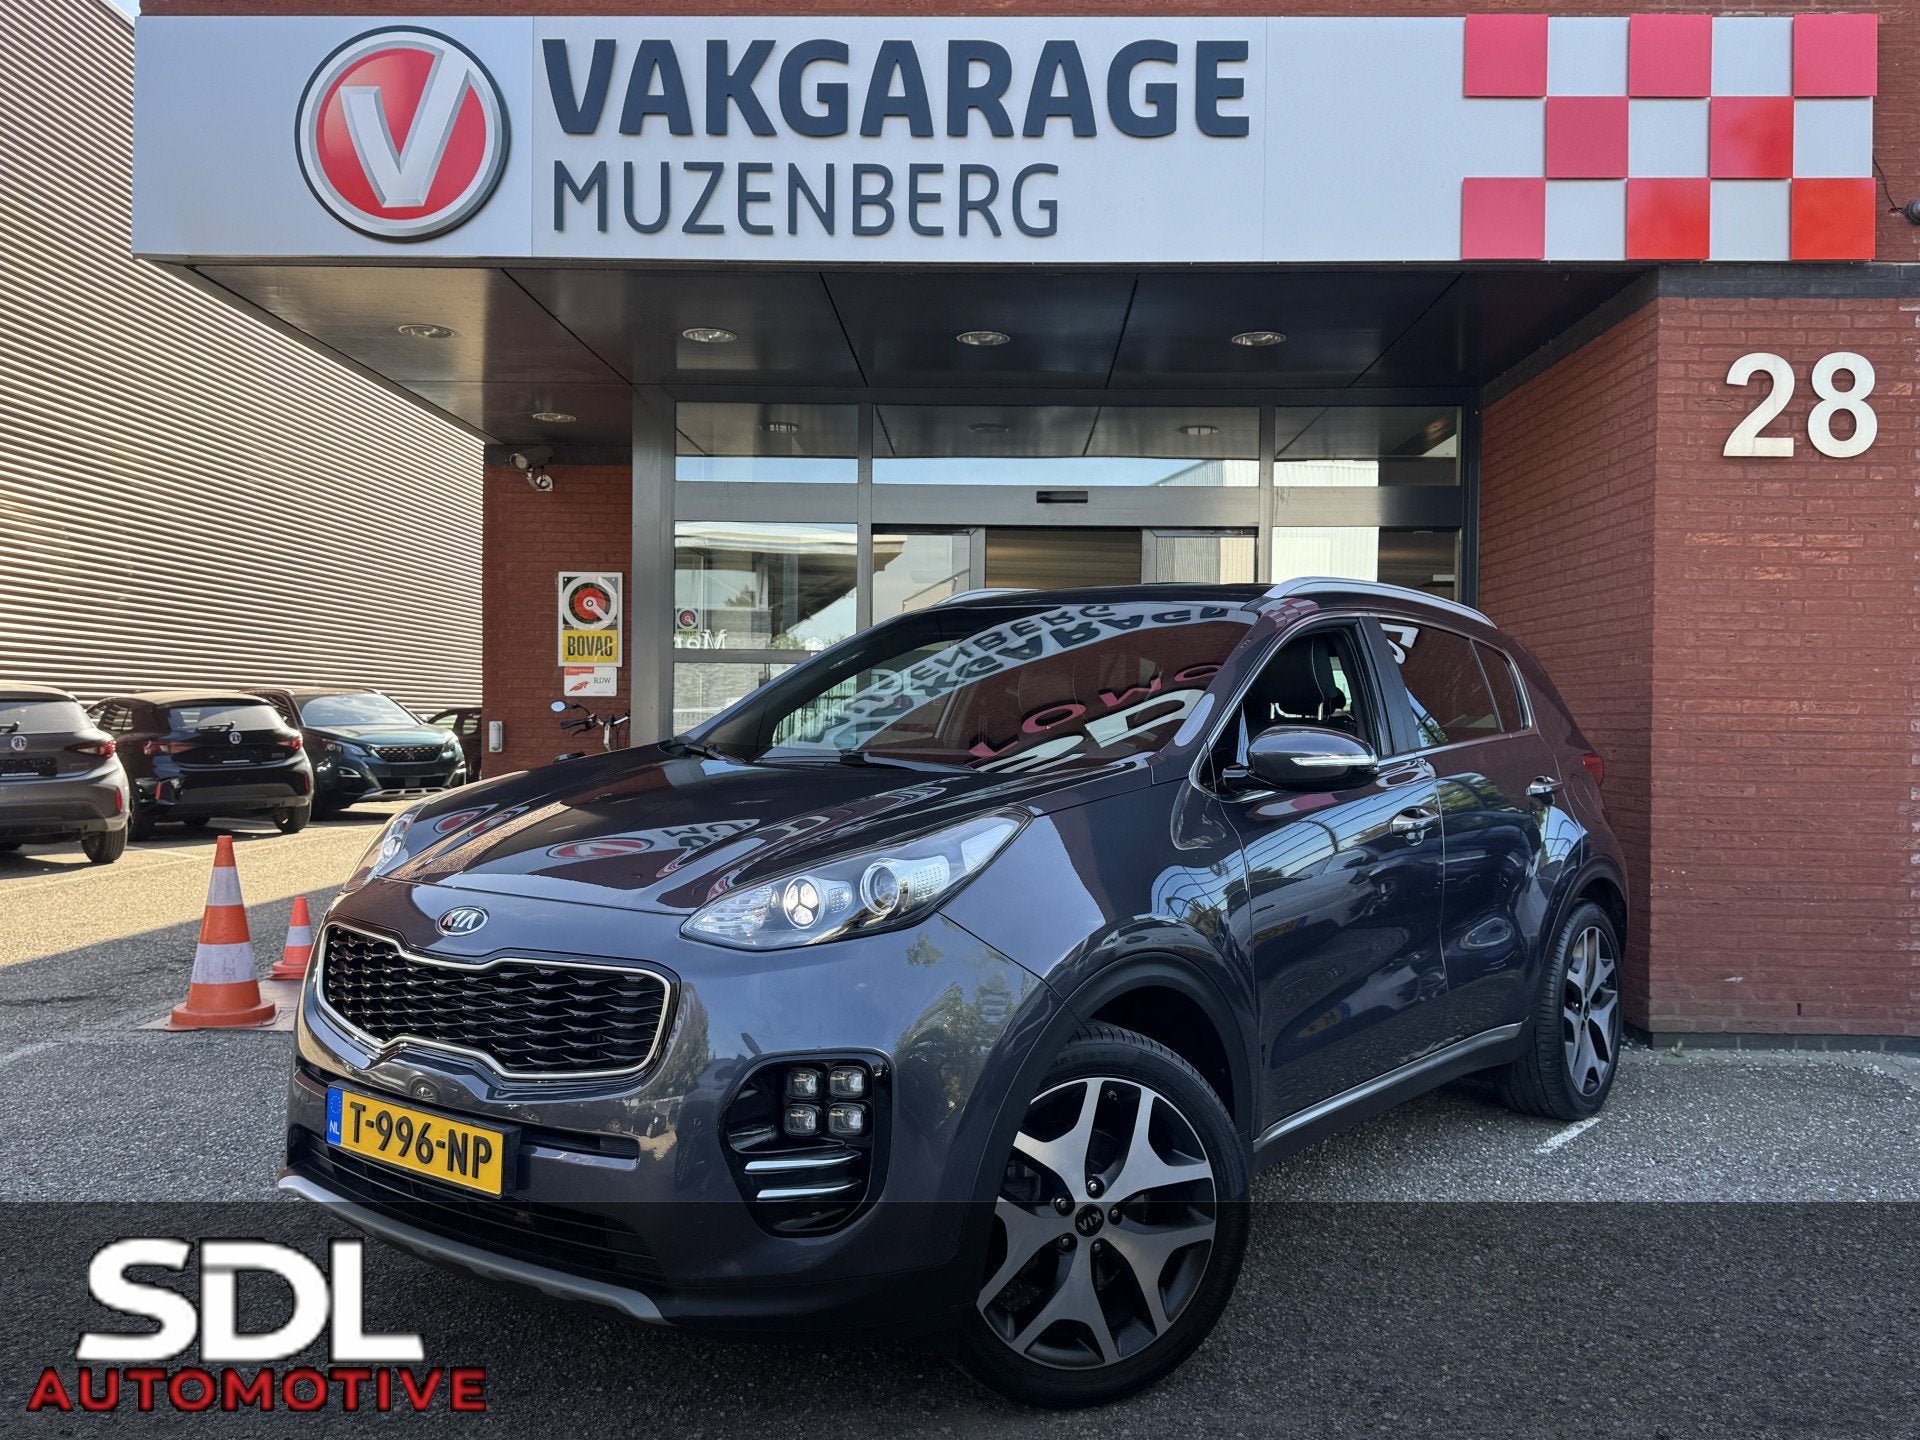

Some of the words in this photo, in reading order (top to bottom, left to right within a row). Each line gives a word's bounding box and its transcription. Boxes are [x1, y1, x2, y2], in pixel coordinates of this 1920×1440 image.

[543, 38, 1249, 140] VAKGARAGE
[554, 160, 1059, 238] MUZENBERG
[1722, 351, 1878, 458] 28
[567, 635, 613, 656] BOVAG
[441, 910, 478, 930] KIA
[329, 1120, 340, 1136] NL
[350, 1101, 492, 1179] T-996-NP
